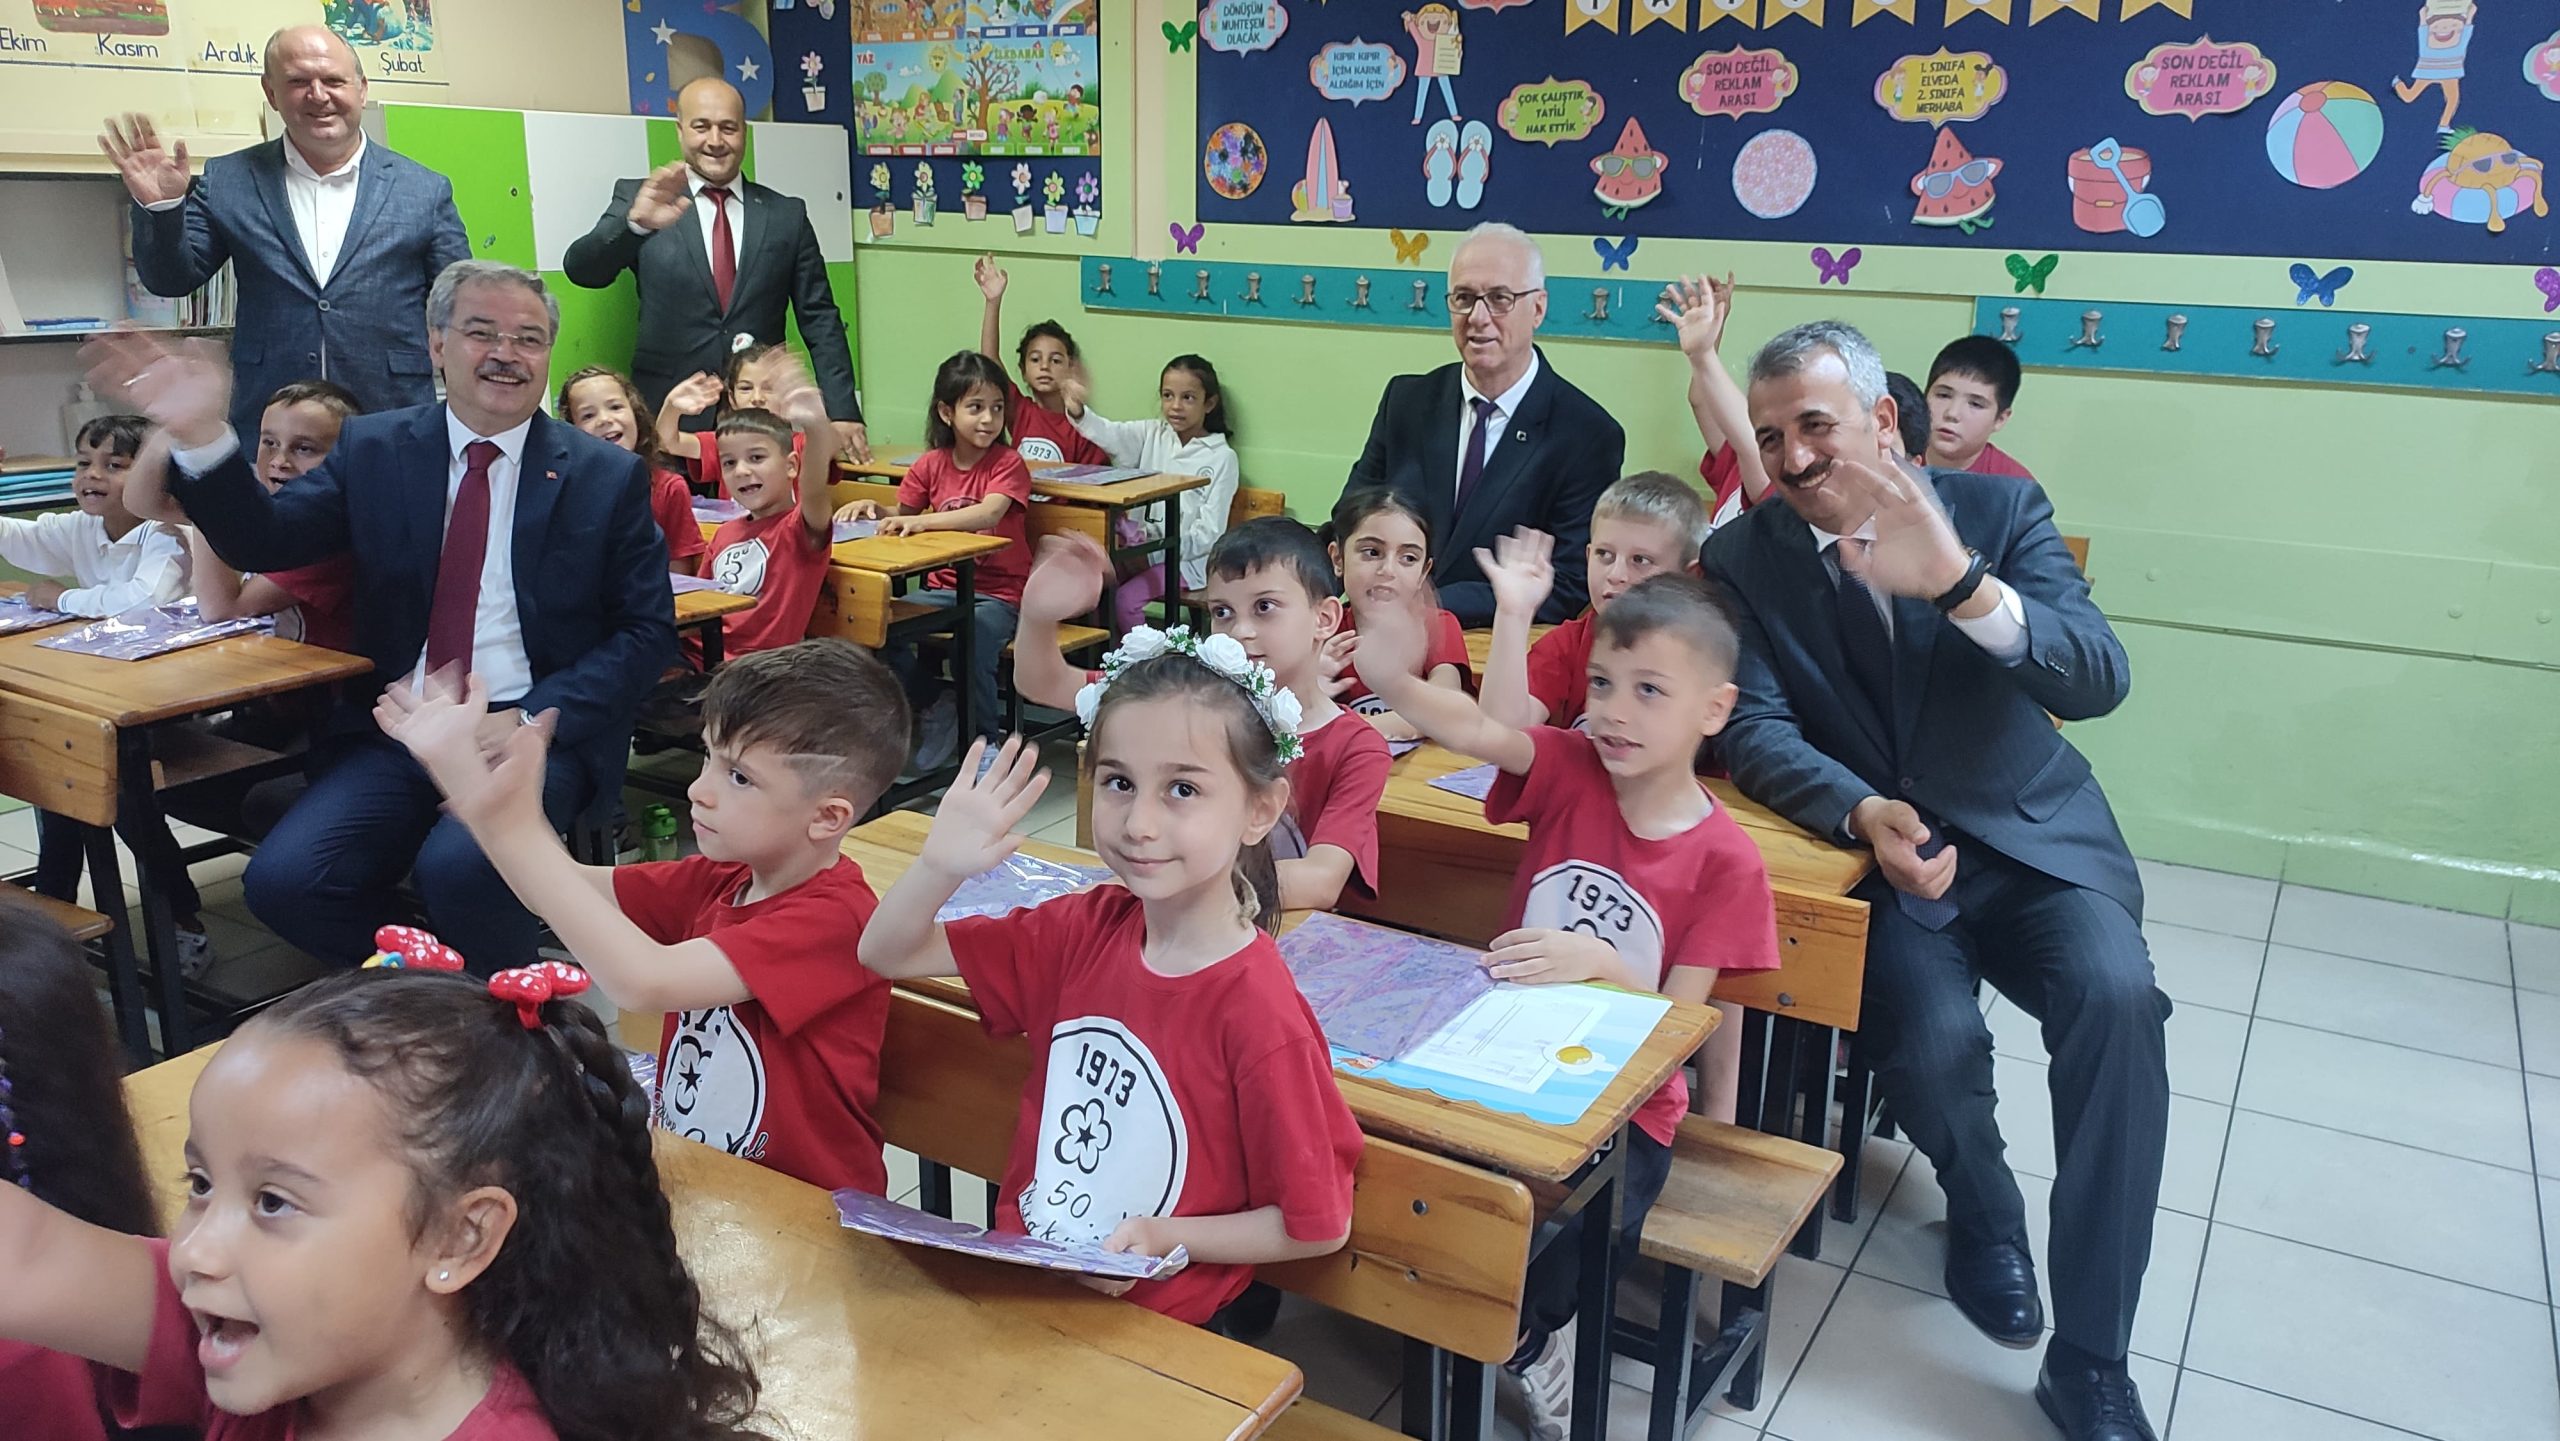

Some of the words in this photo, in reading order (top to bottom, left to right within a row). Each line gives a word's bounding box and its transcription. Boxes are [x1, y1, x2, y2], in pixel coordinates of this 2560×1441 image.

[1223, 2, 1263, 17] DÖNÜŞÜM
[1221, 18, 1265, 32] MUHTEŞEM
[0, 27, 47, 52] Ekim
[97, 33, 159, 58] Kasım
[1227, 32, 1260, 45] OLACAK
[204, 41, 259, 65] Aralık
[856, 53, 875, 65] YAZ
[2161, 55, 2194, 70] SON
[2200, 50, 2244, 69] DEĞİL
[380, 51, 426, 76] Şubat
[1706, 62, 1732, 76] SON
[1735, 56, 1772, 74] DEĞİL
[1930, 60, 1965, 72] SINIFA
[1714, 76, 1762, 91] REKLAM
[1921, 74, 1959, 86] ELVEDA
[2170, 73, 2231, 88] REKLAM
[1518, 93, 1539, 107] ÇOK
[1541, 90, 1584, 104] ÇALIŞTIK
[1719, 92, 1757, 107] ARASI
[1929, 87, 1965, 99] SINIFA
[2173, 90, 2222, 106] ARASI
[1536, 104, 1565, 118] TATİLİ
[1916, 101, 1963, 112] MERHABA
[1526, 124, 1547, 133] HAK
[1549, 119, 1576, 133] ETTİK
[1028, 445, 1051, 459] 1973
[1567, 874, 1633, 932] 1973
[1075, 1042, 1137, 1108] 1973
